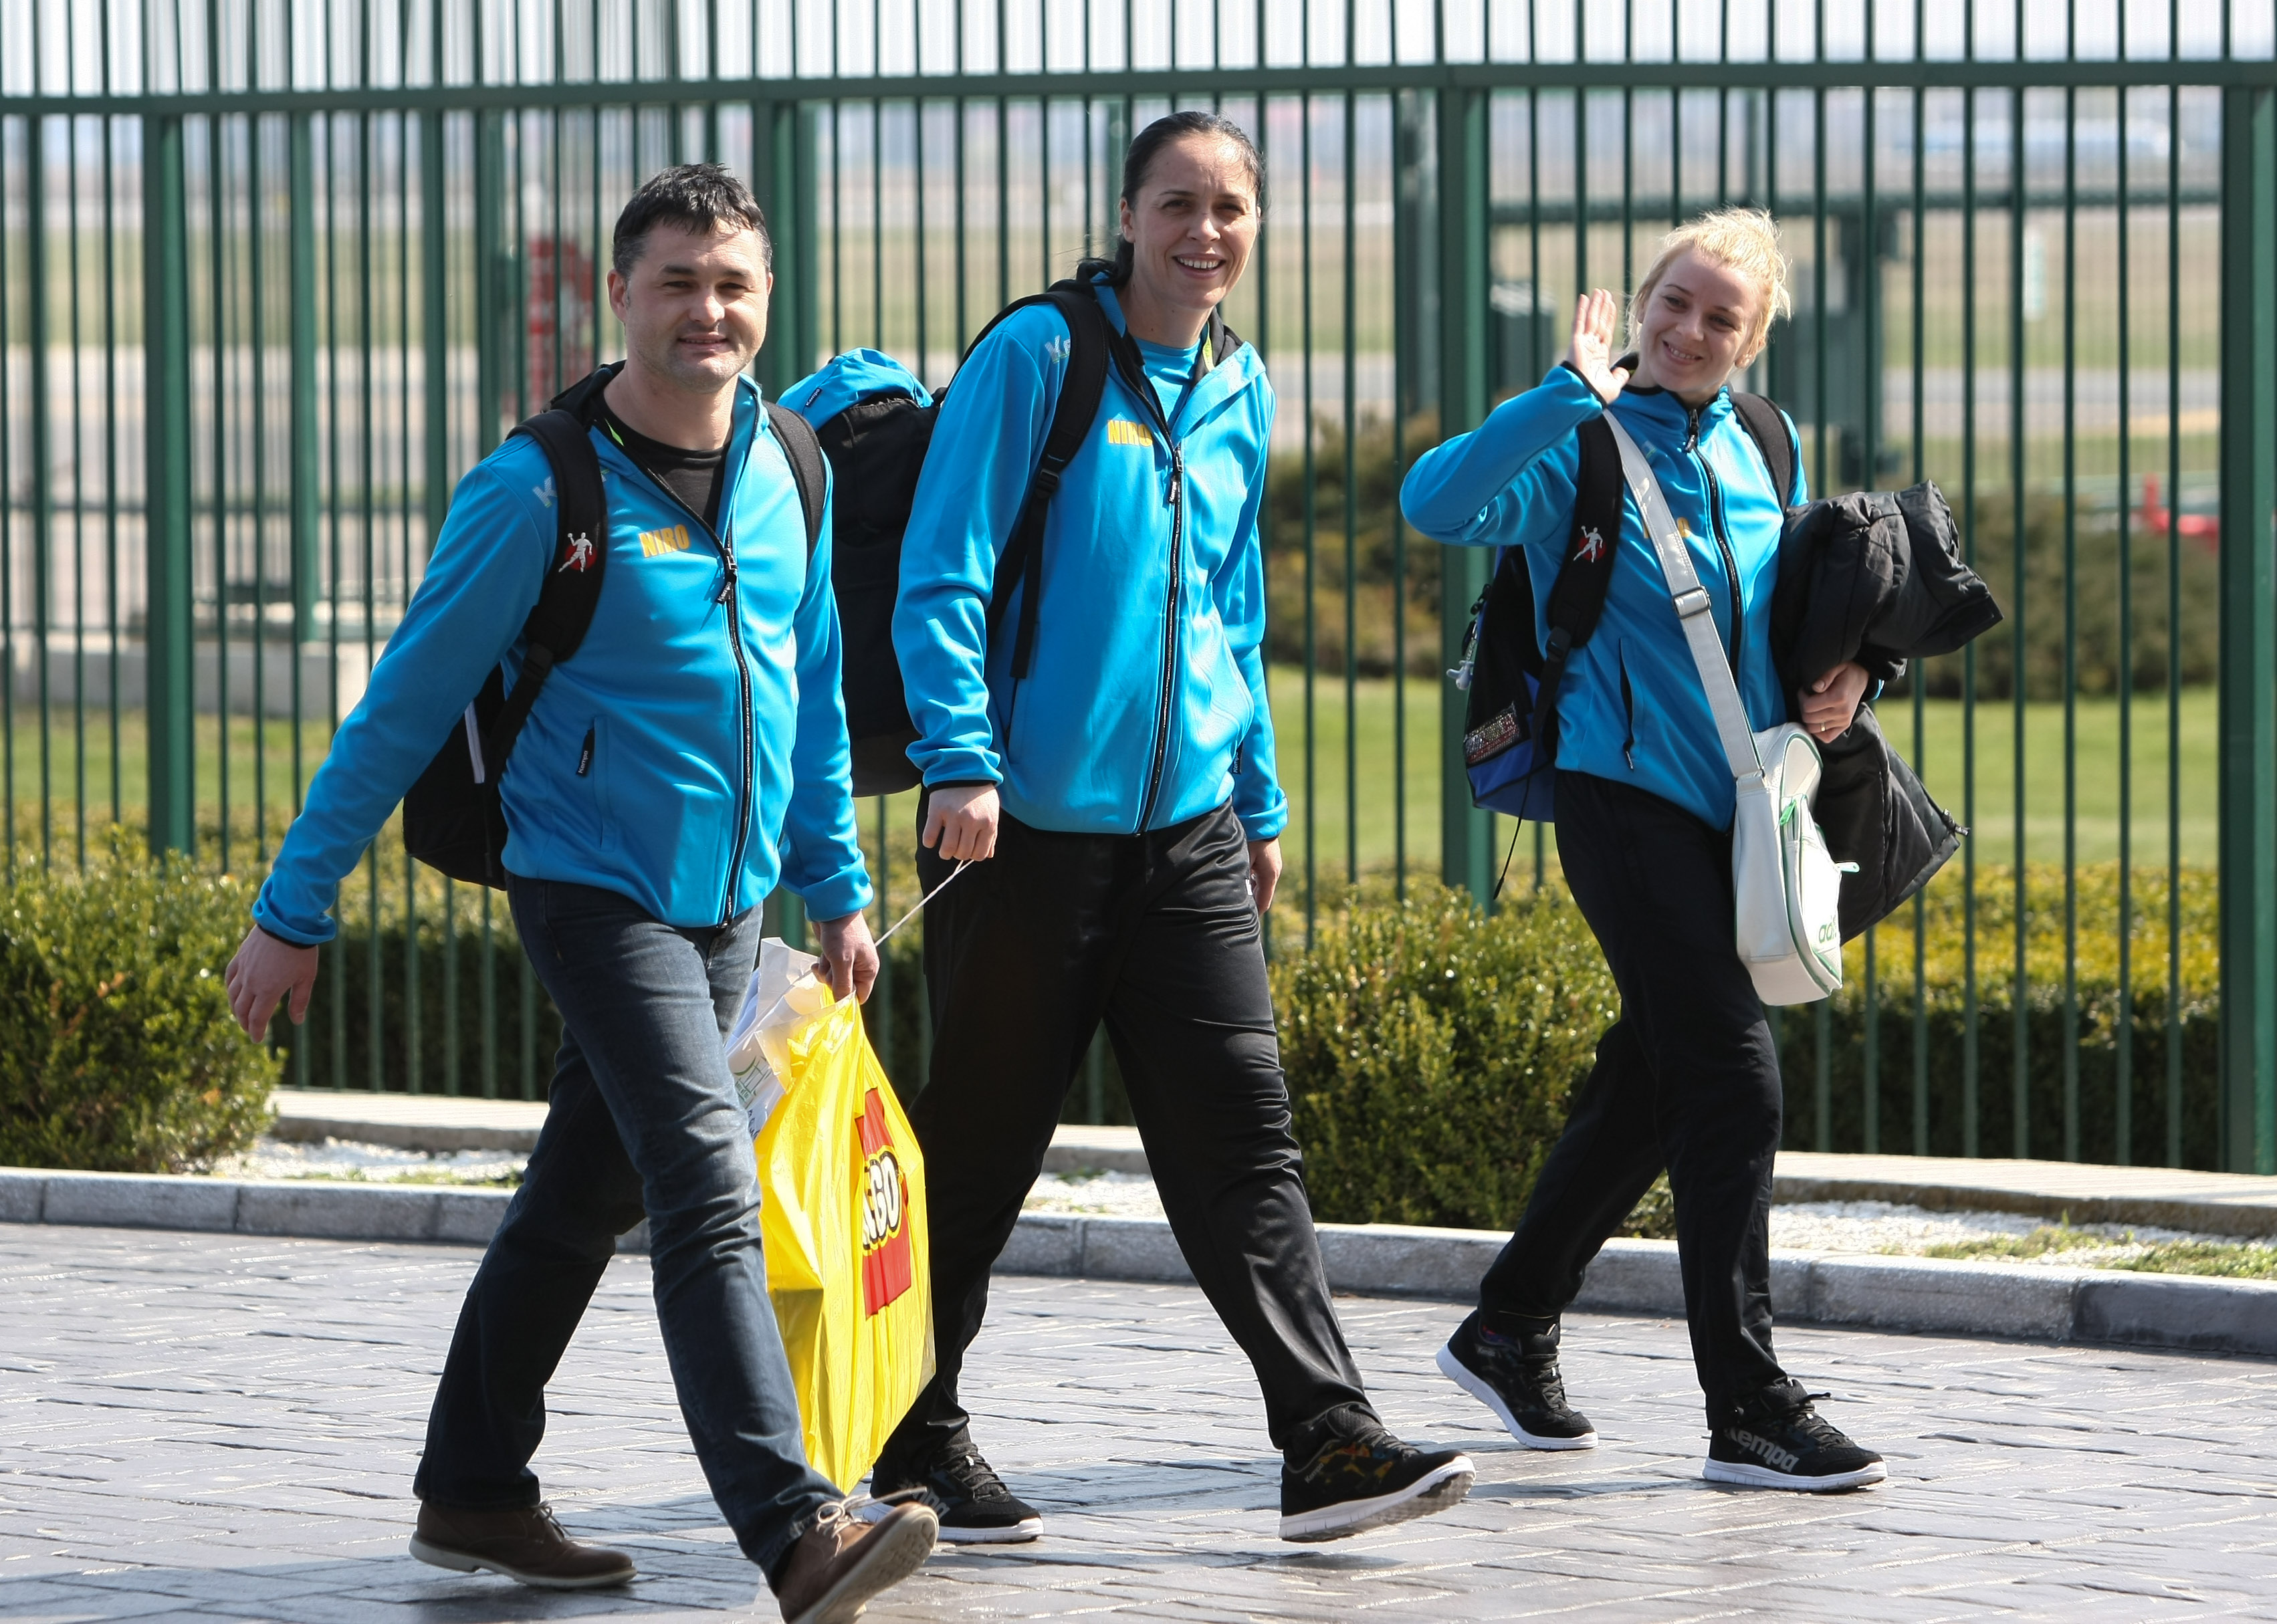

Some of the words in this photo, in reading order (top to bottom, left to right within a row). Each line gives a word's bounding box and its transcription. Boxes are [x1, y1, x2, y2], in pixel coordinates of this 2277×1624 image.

[1107, 419, 1153, 447] NIRO
[639, 524, 690, 558] NIRO
[578, 750, 588, 774] Kempa
